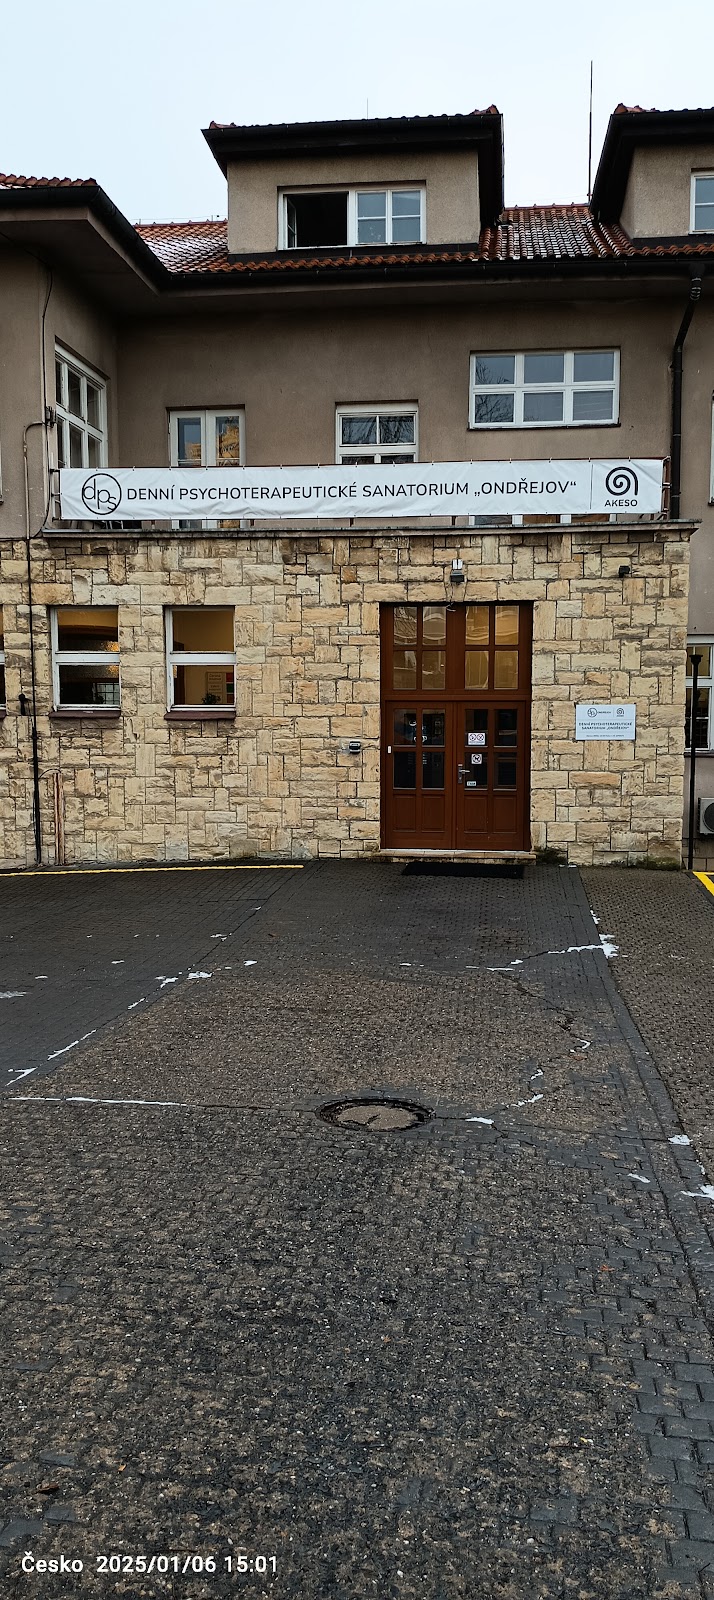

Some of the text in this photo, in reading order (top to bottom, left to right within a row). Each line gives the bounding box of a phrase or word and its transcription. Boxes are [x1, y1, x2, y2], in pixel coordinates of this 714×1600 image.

[127, 477, 577, 500] DENNÍ PSYCHOTERAPEUTICKÉ SANATORIUM „ONDŘEJOV“
[604, 499, 638, 507] AKESO
